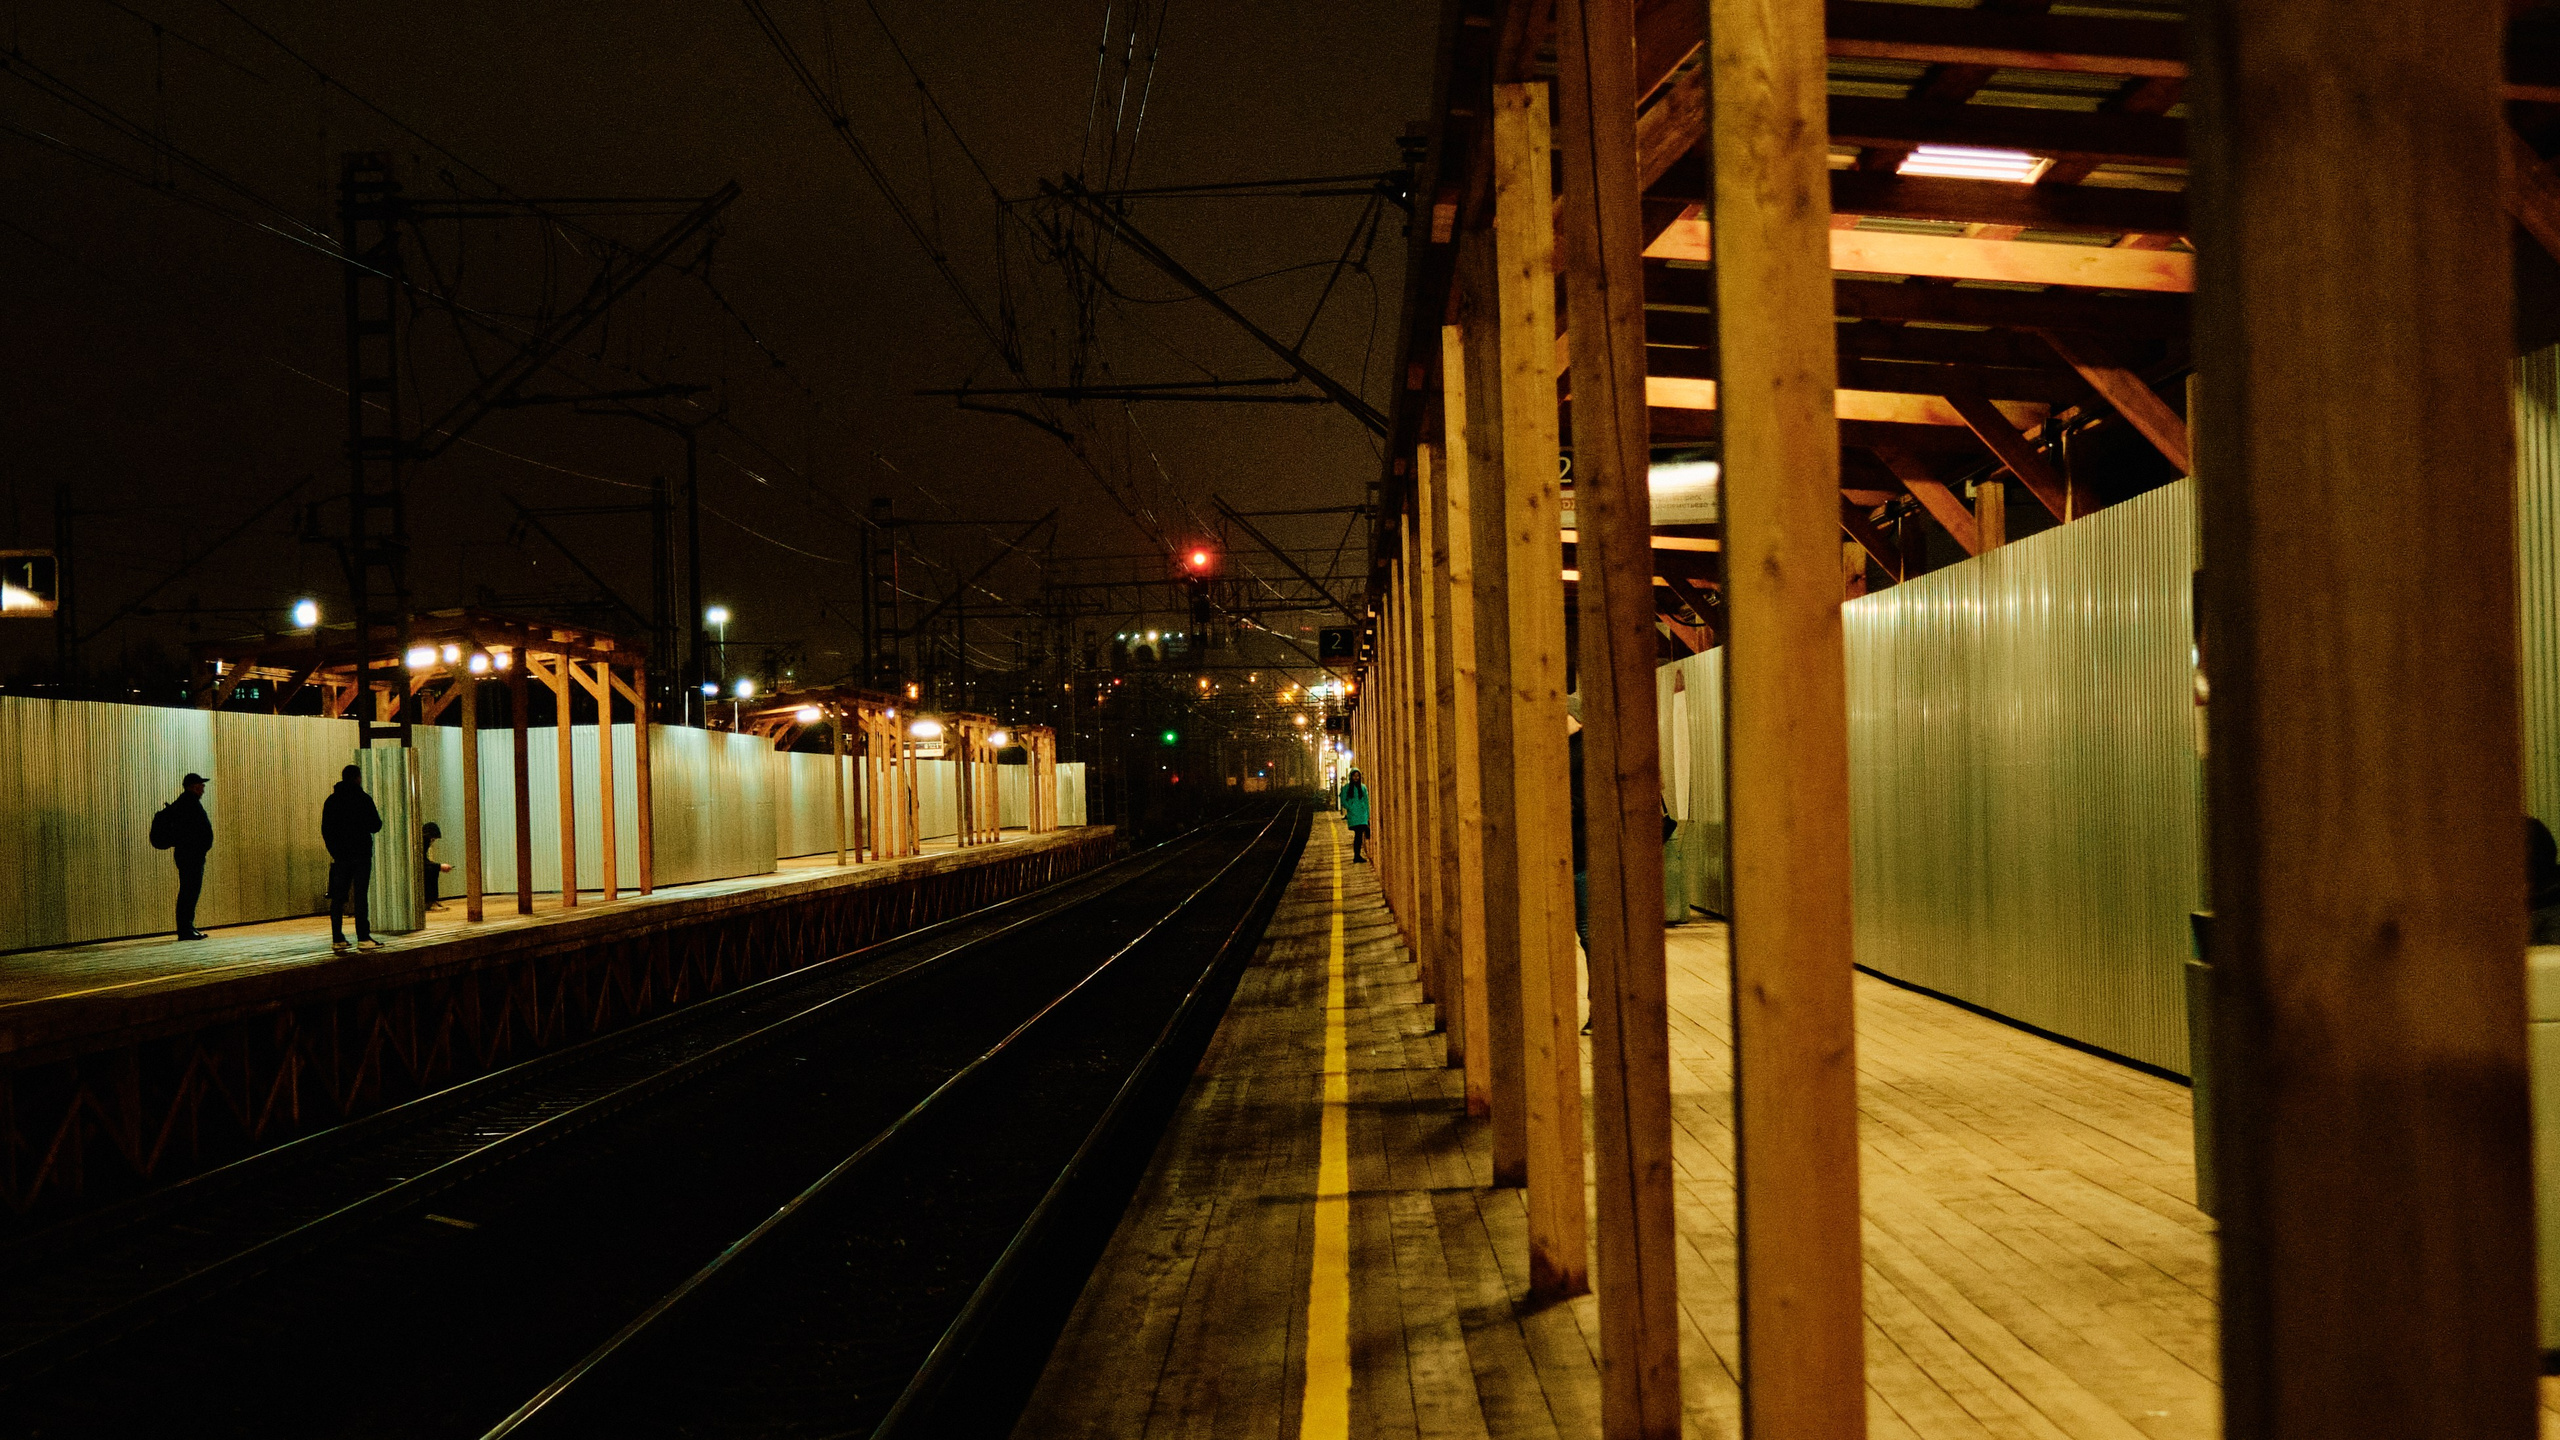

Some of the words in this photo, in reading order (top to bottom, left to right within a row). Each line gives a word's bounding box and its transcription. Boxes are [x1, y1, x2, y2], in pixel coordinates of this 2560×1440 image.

[1560, 456, 1572, 484] 2
[22, 561, 33, 589] 1
[1331, 632, 1343, 650] 2
